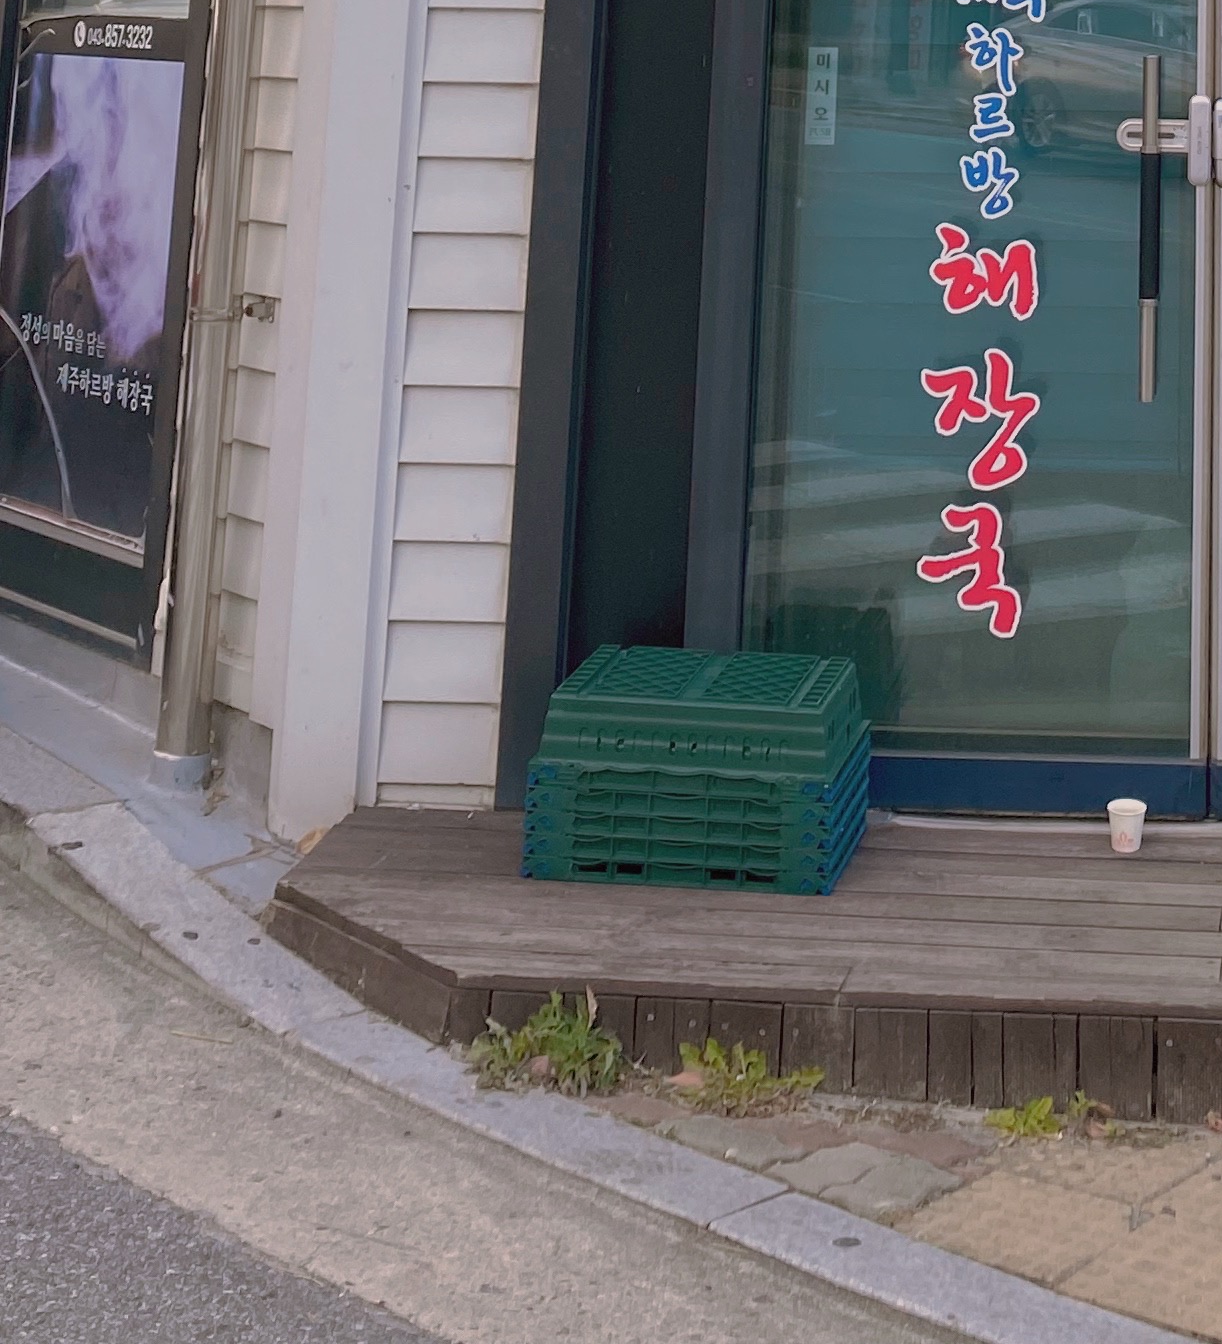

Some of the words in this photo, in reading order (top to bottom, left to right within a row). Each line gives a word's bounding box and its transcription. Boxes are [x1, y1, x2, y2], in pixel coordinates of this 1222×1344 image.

[813, 53, 831, 121] 미시오
[963, 26, 1022, 215] 하르방
[20, 313, 51, 345] 정성의
[53, 320, 85, 354] 마음을
[87, 332, 106, 358] 담는
[56, 363, 114, 405] 제주하르방
[116, 377, 153, 416] 해장국
[921, 226, 1037, 633] 해장국
